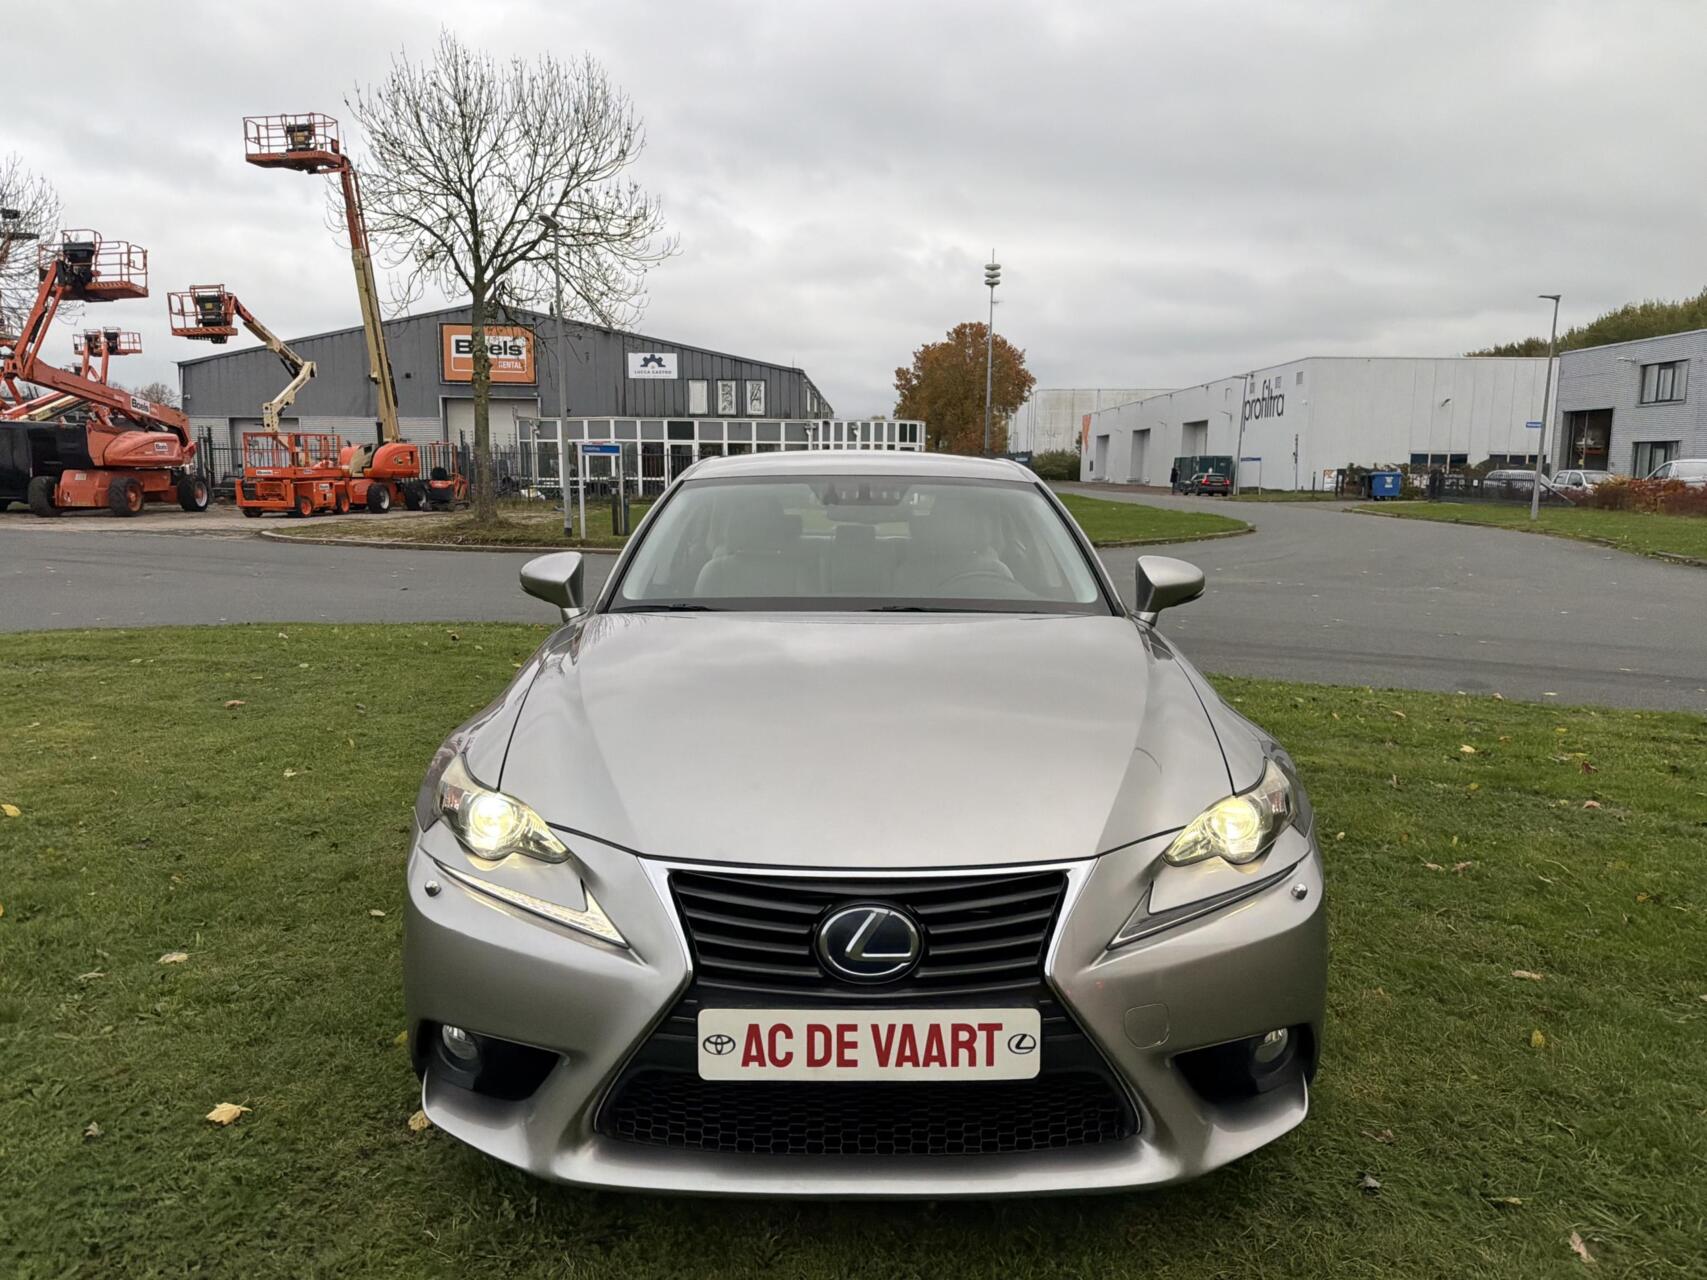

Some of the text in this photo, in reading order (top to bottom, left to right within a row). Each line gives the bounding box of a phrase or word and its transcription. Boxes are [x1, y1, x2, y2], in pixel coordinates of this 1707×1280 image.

[455, 339, 522, 356] Bels
[498, 361, 522, 369] RENTAL
[1243, 379, 1284, 432] profiltra
[741, 1023, 1003, 1068] AC DE VAART
